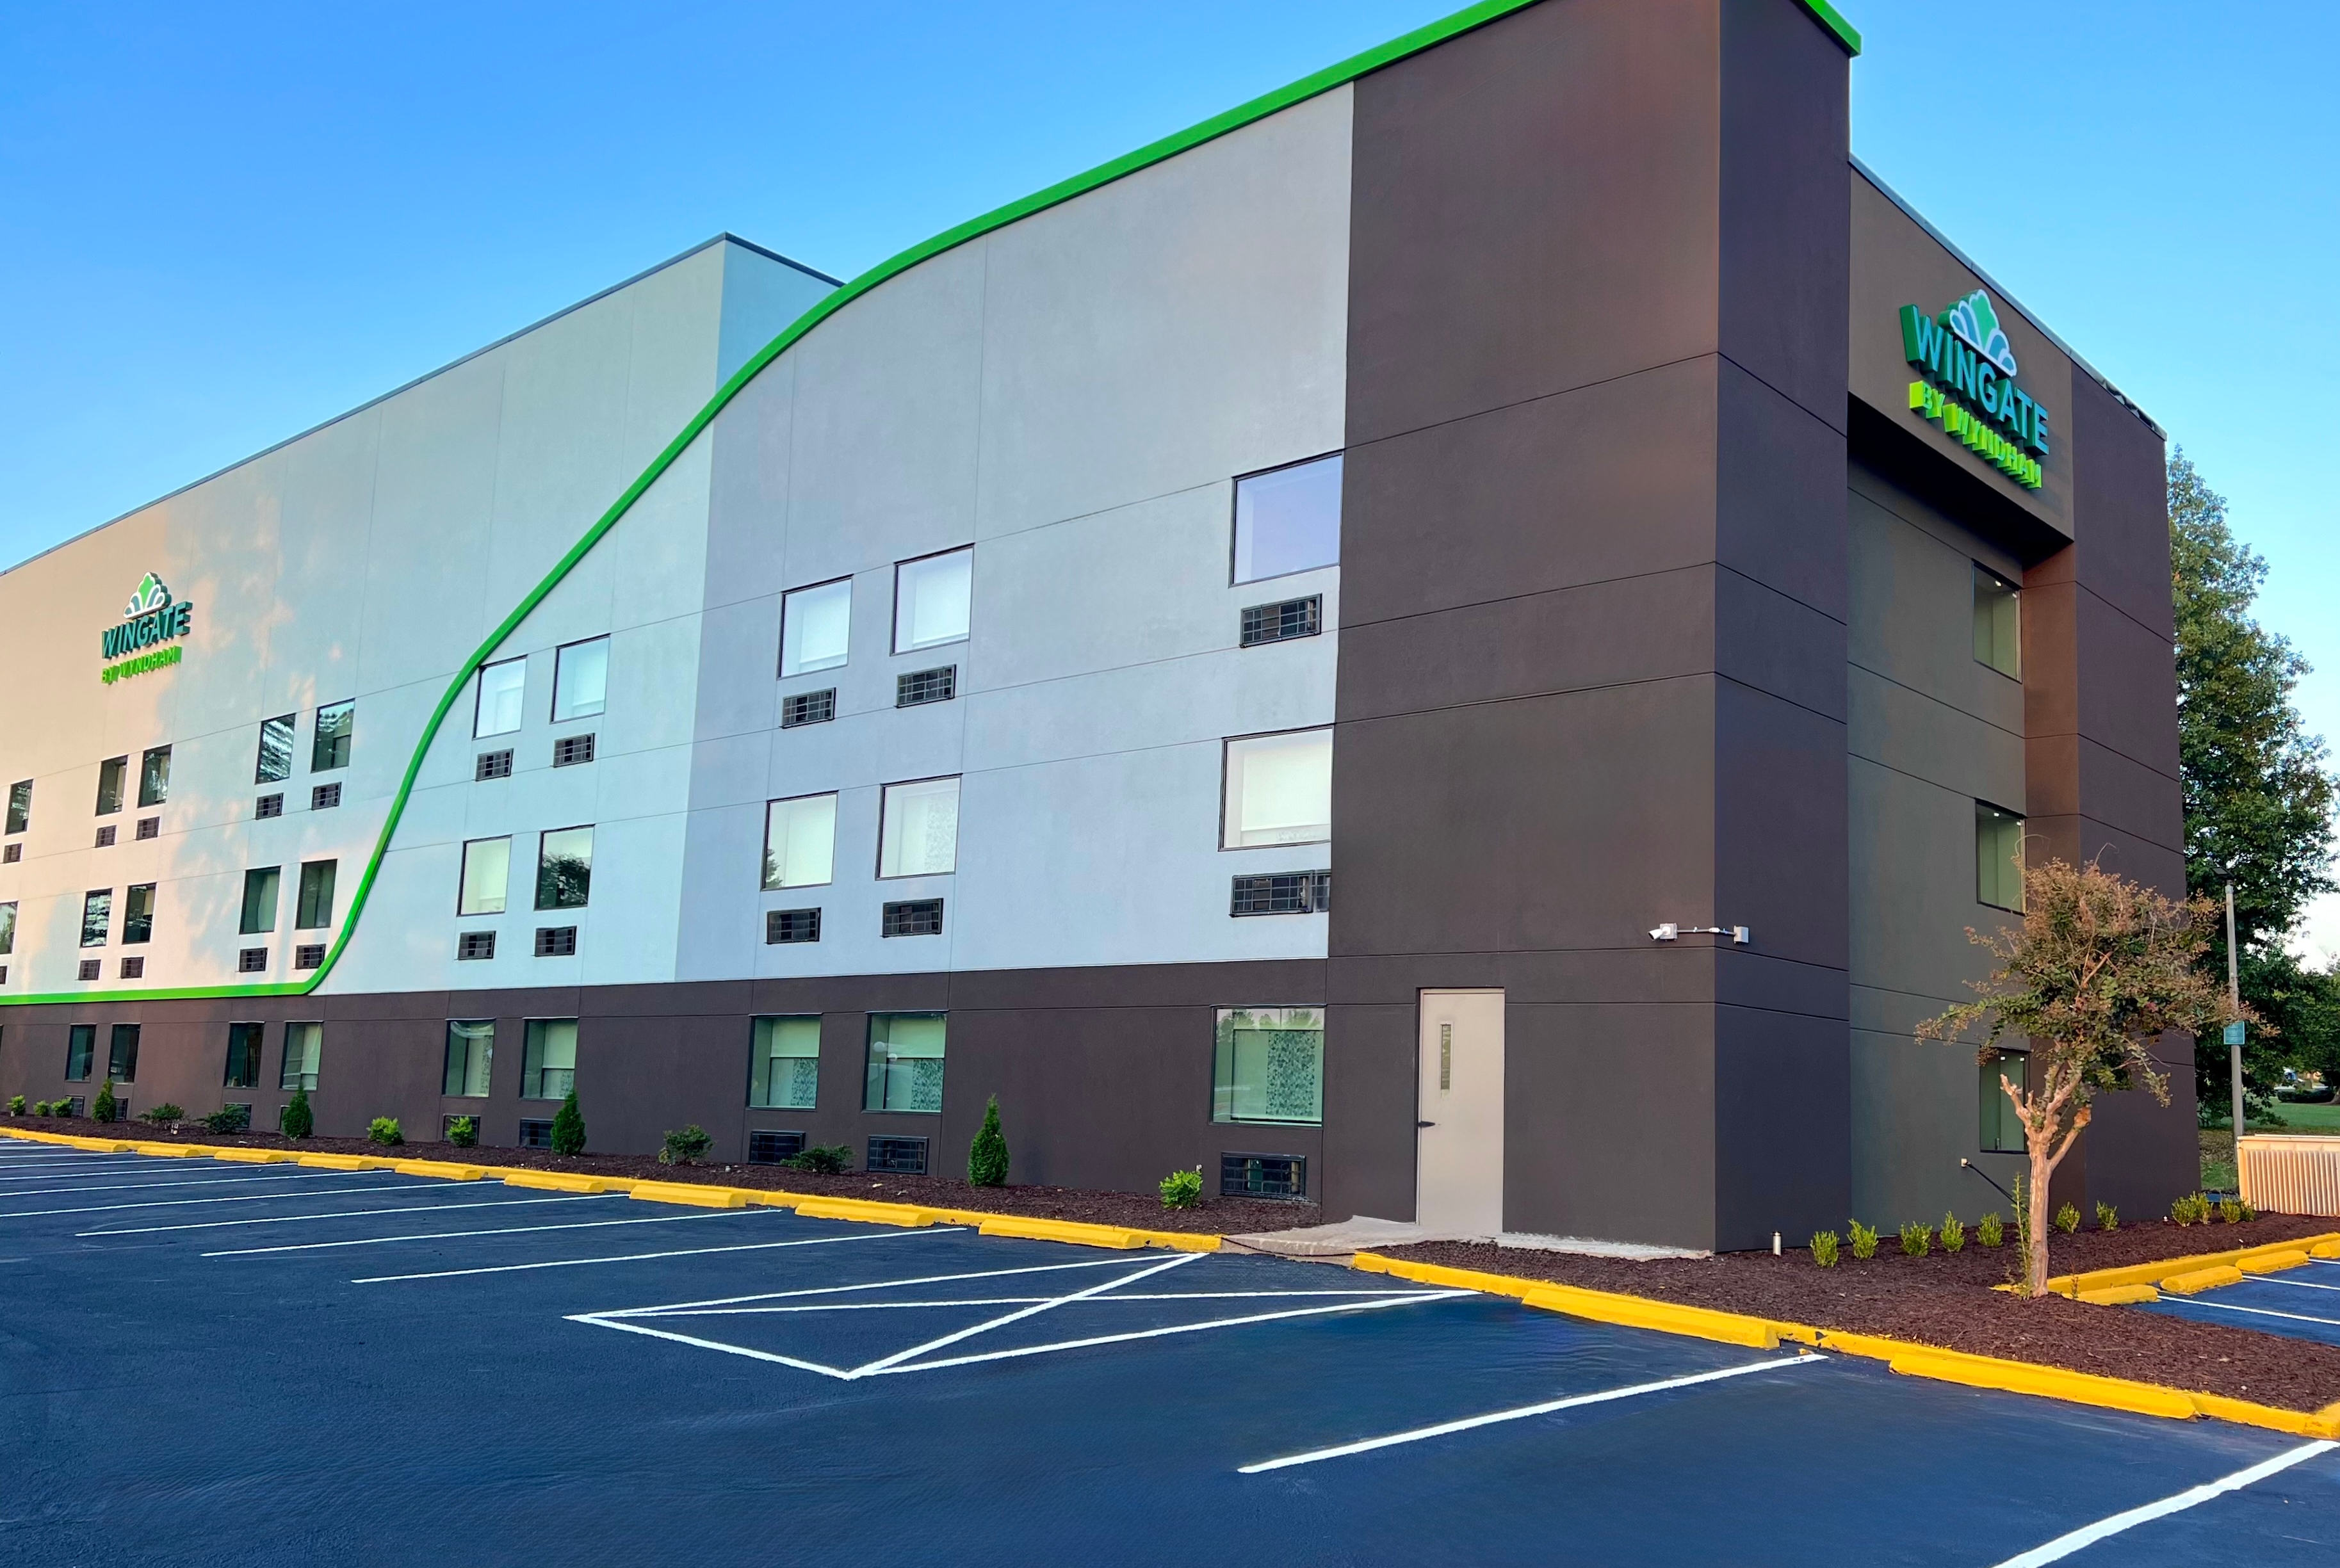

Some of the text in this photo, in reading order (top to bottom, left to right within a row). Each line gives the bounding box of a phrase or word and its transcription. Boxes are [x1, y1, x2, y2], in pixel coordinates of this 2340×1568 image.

[1900, 304, 2049, 456] WINGATE
[1910, 381, 2042, 489] BY WYNDHAM
[102, 602, 193, 659] WINGATE
[102, 645, 182, 685] BY WYNDHAM
